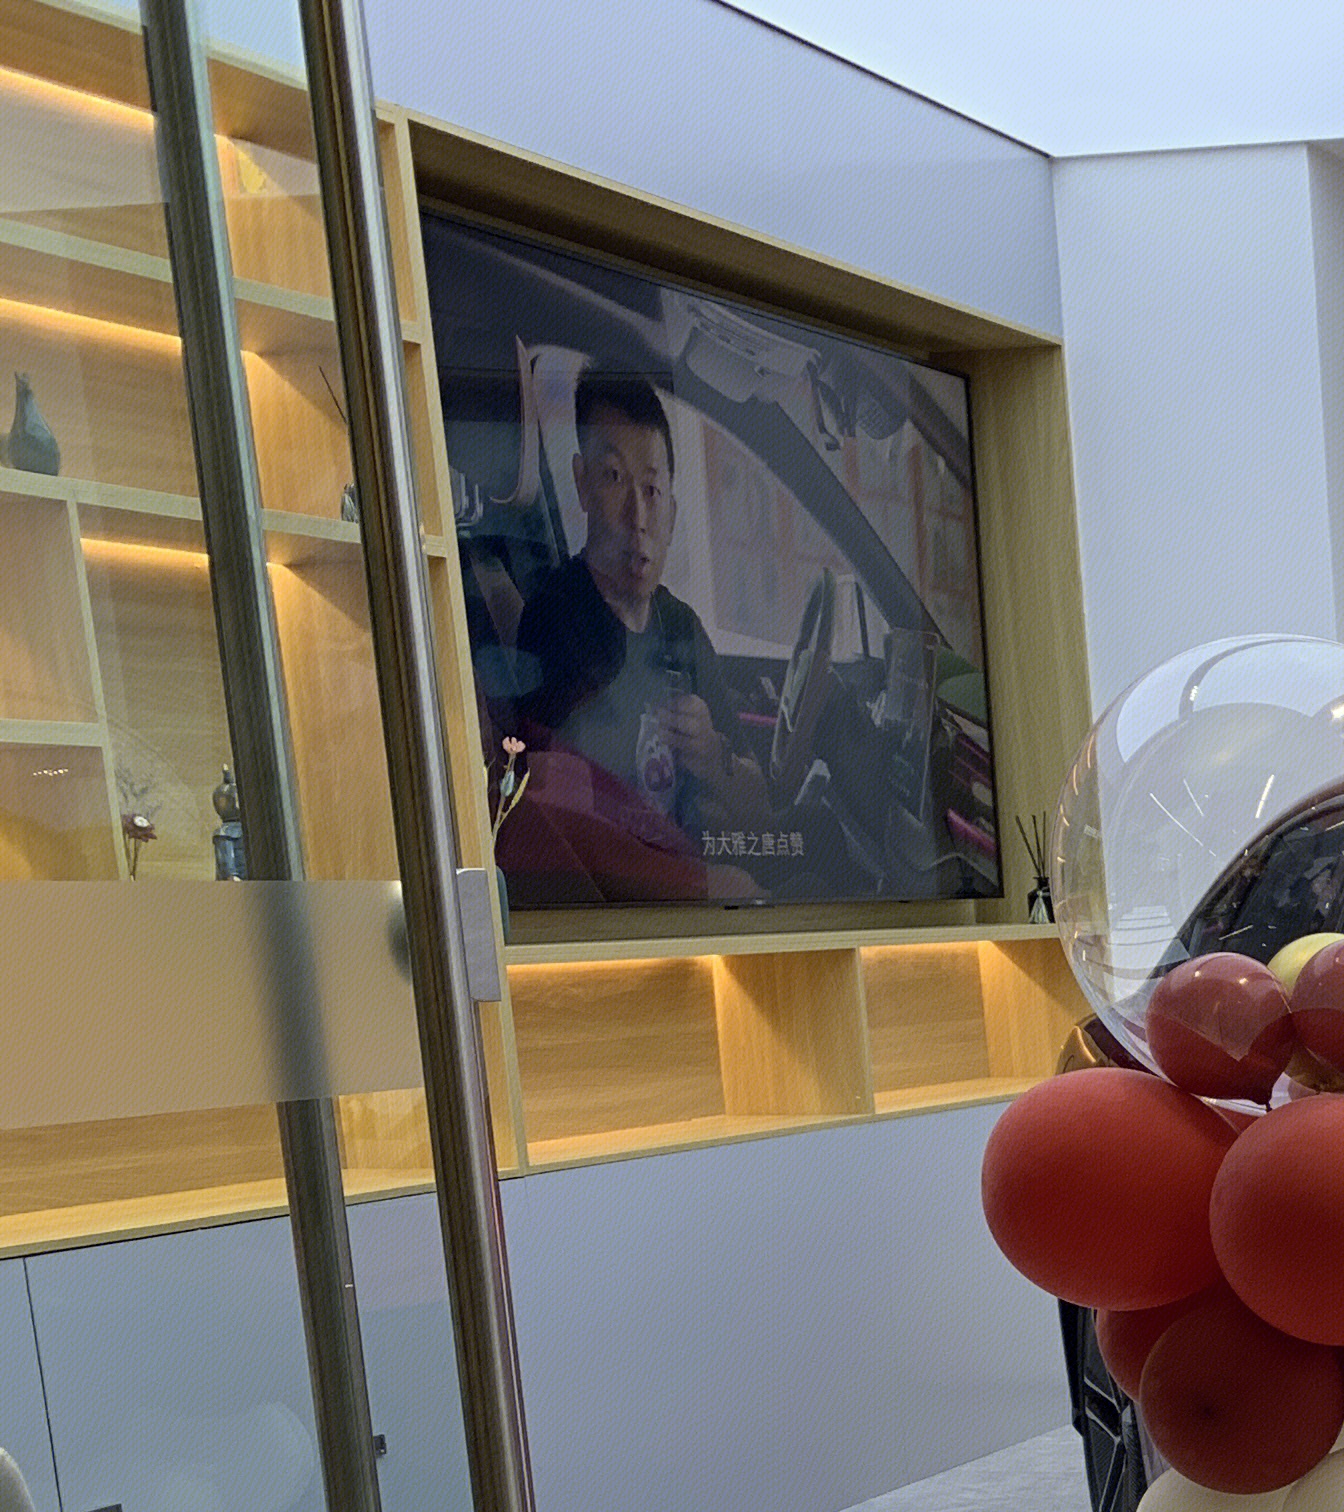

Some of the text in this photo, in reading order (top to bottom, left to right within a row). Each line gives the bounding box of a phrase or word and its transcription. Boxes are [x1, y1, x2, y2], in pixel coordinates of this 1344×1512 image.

[701, 830, 804, 857] 为大雅之唐点赞
